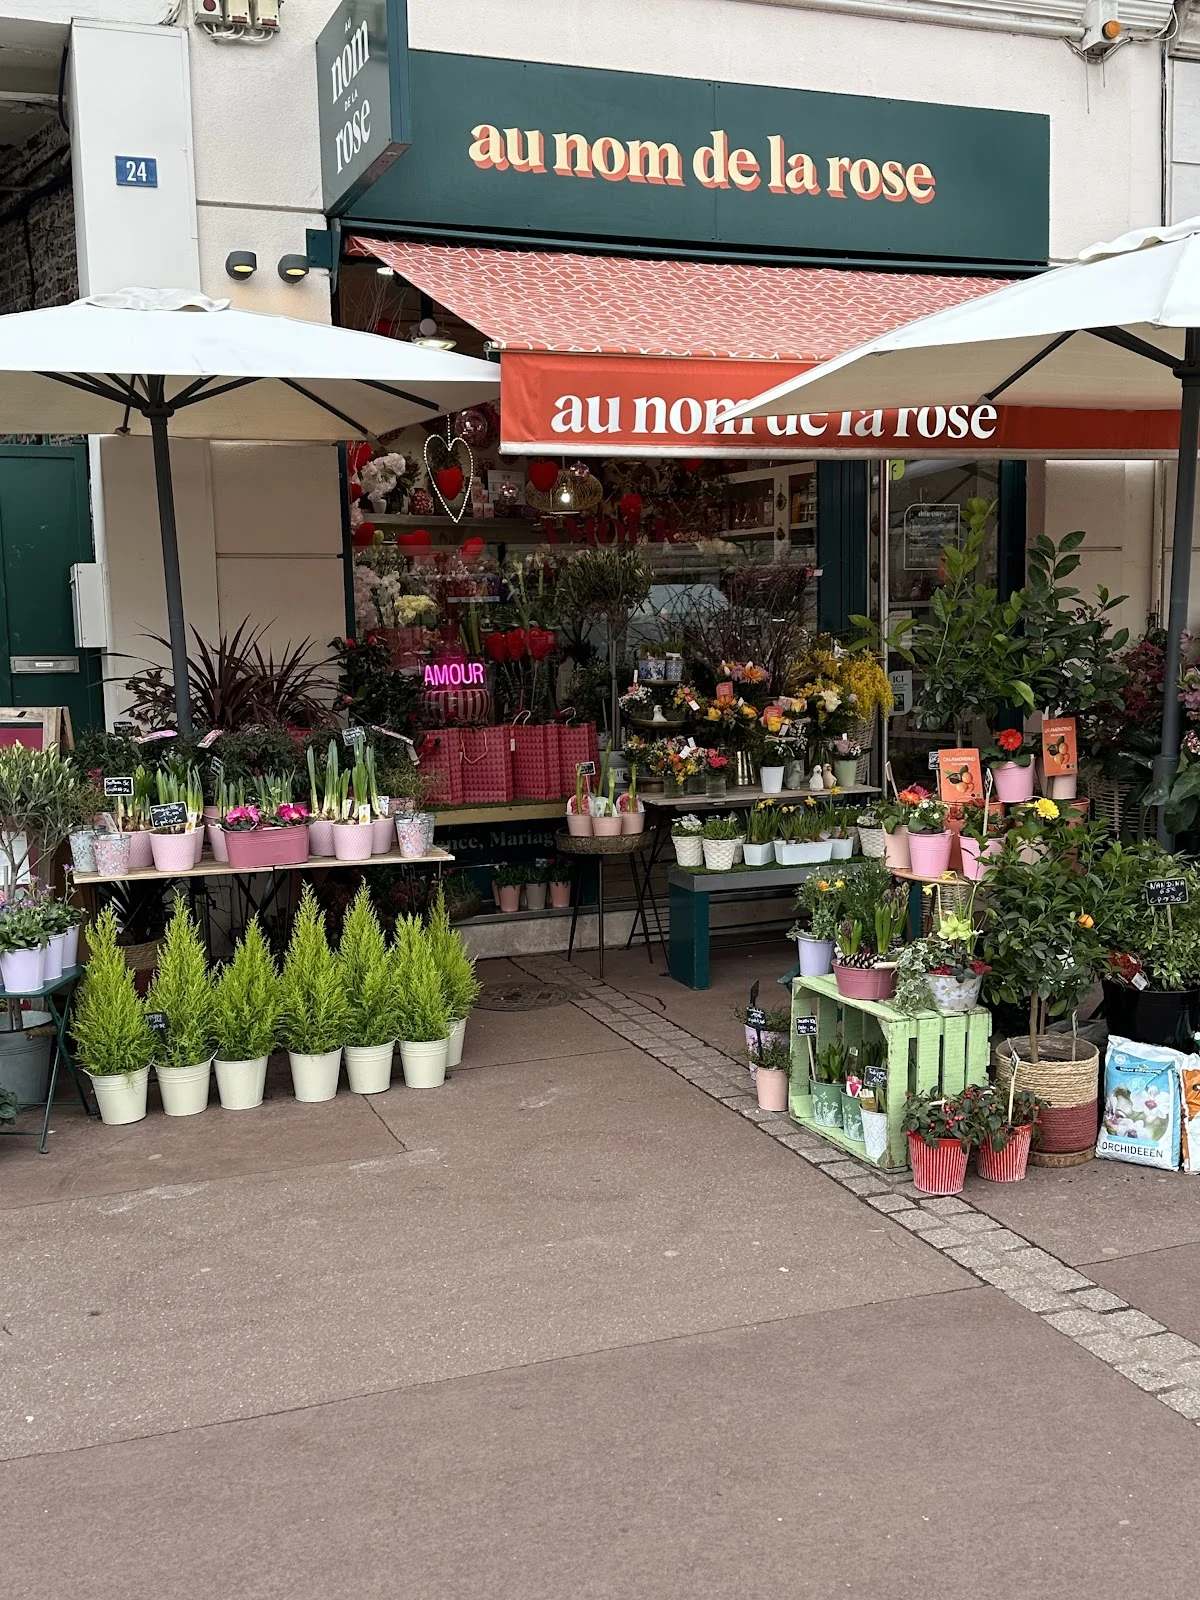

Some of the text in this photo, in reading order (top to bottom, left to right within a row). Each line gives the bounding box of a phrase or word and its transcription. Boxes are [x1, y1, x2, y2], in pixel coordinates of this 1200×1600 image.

[331, 20, 370, 104] nom
[335, 100, 371, 174] rose
[126, 161, 146, 182] 24
[468, 124, 936, 204] au nom de la rose
[550, 395, 622, 434] au
[893, 404, 998, 440] rose
[424, 663, 484, 686] AMOUR
[489, 829, 556, 847] Mariag
